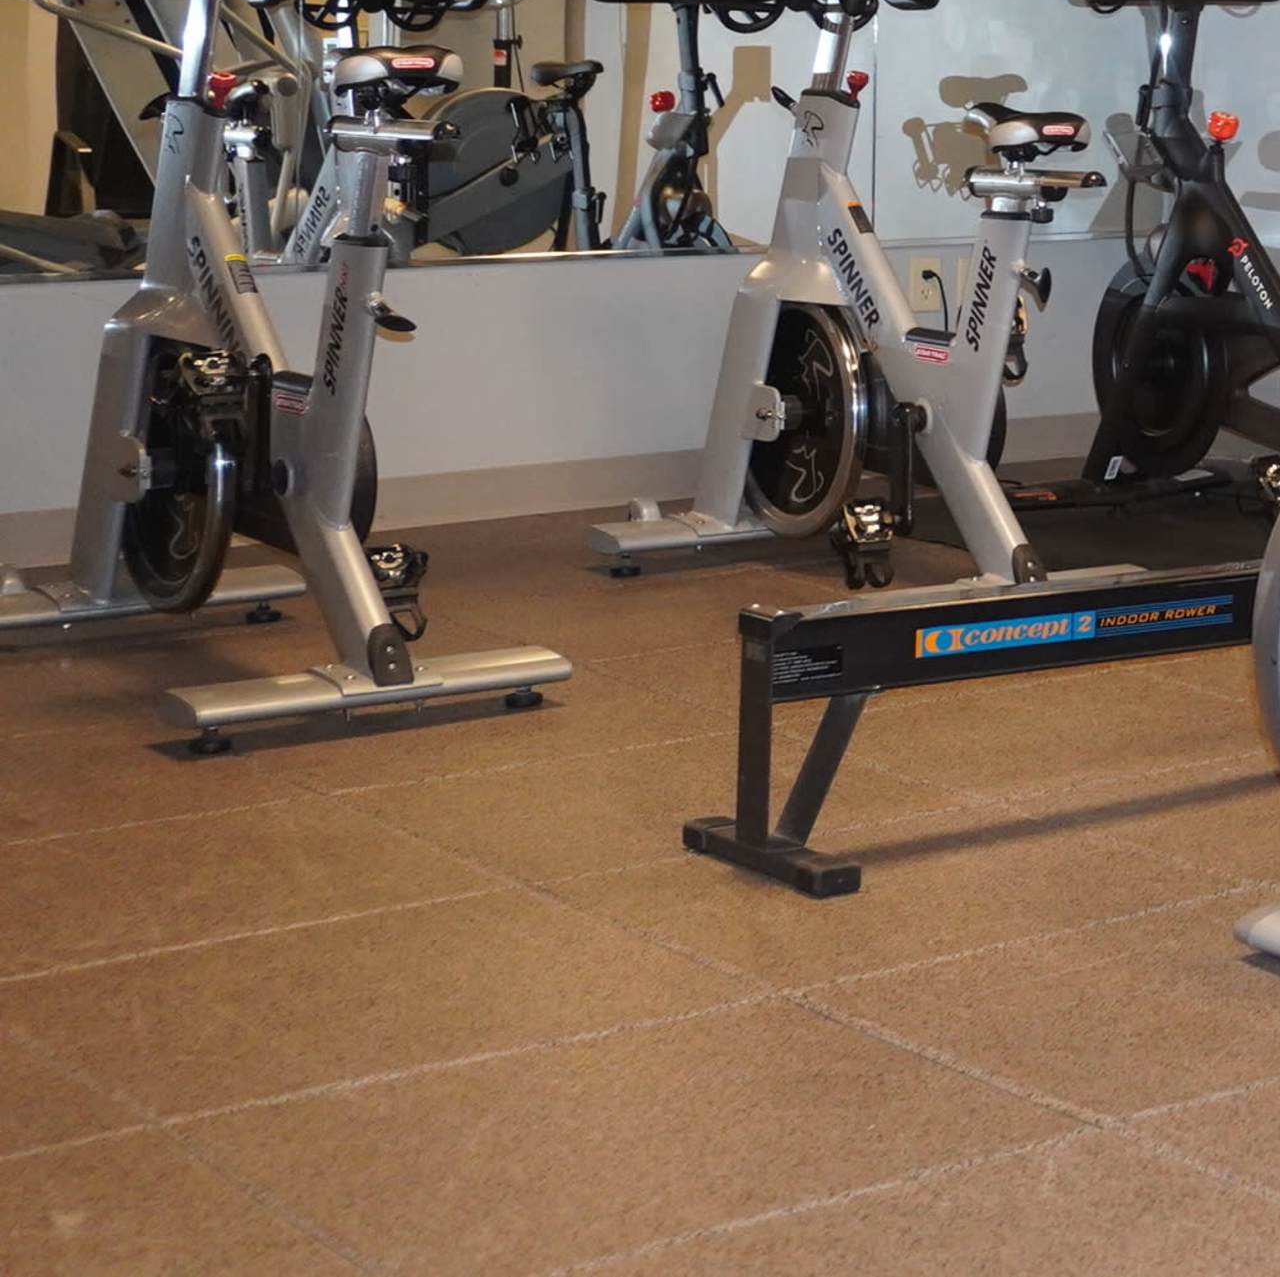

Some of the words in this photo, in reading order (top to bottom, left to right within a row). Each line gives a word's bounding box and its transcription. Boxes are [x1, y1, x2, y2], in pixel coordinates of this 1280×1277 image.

[826, 227, 881, 329] SPINNER
[965, 245, 998, 352] SPINNER
[1239, 255, 1274, 311] PELOTON
[322, 287, 349, 396] SPINNER
[965, 616, 1070, 645] concept
[1076, 615, 1094, 633] 2
[1100, 610, 1159, 628] INDOOR
[1165, 605, 1217, 620] ROWER
